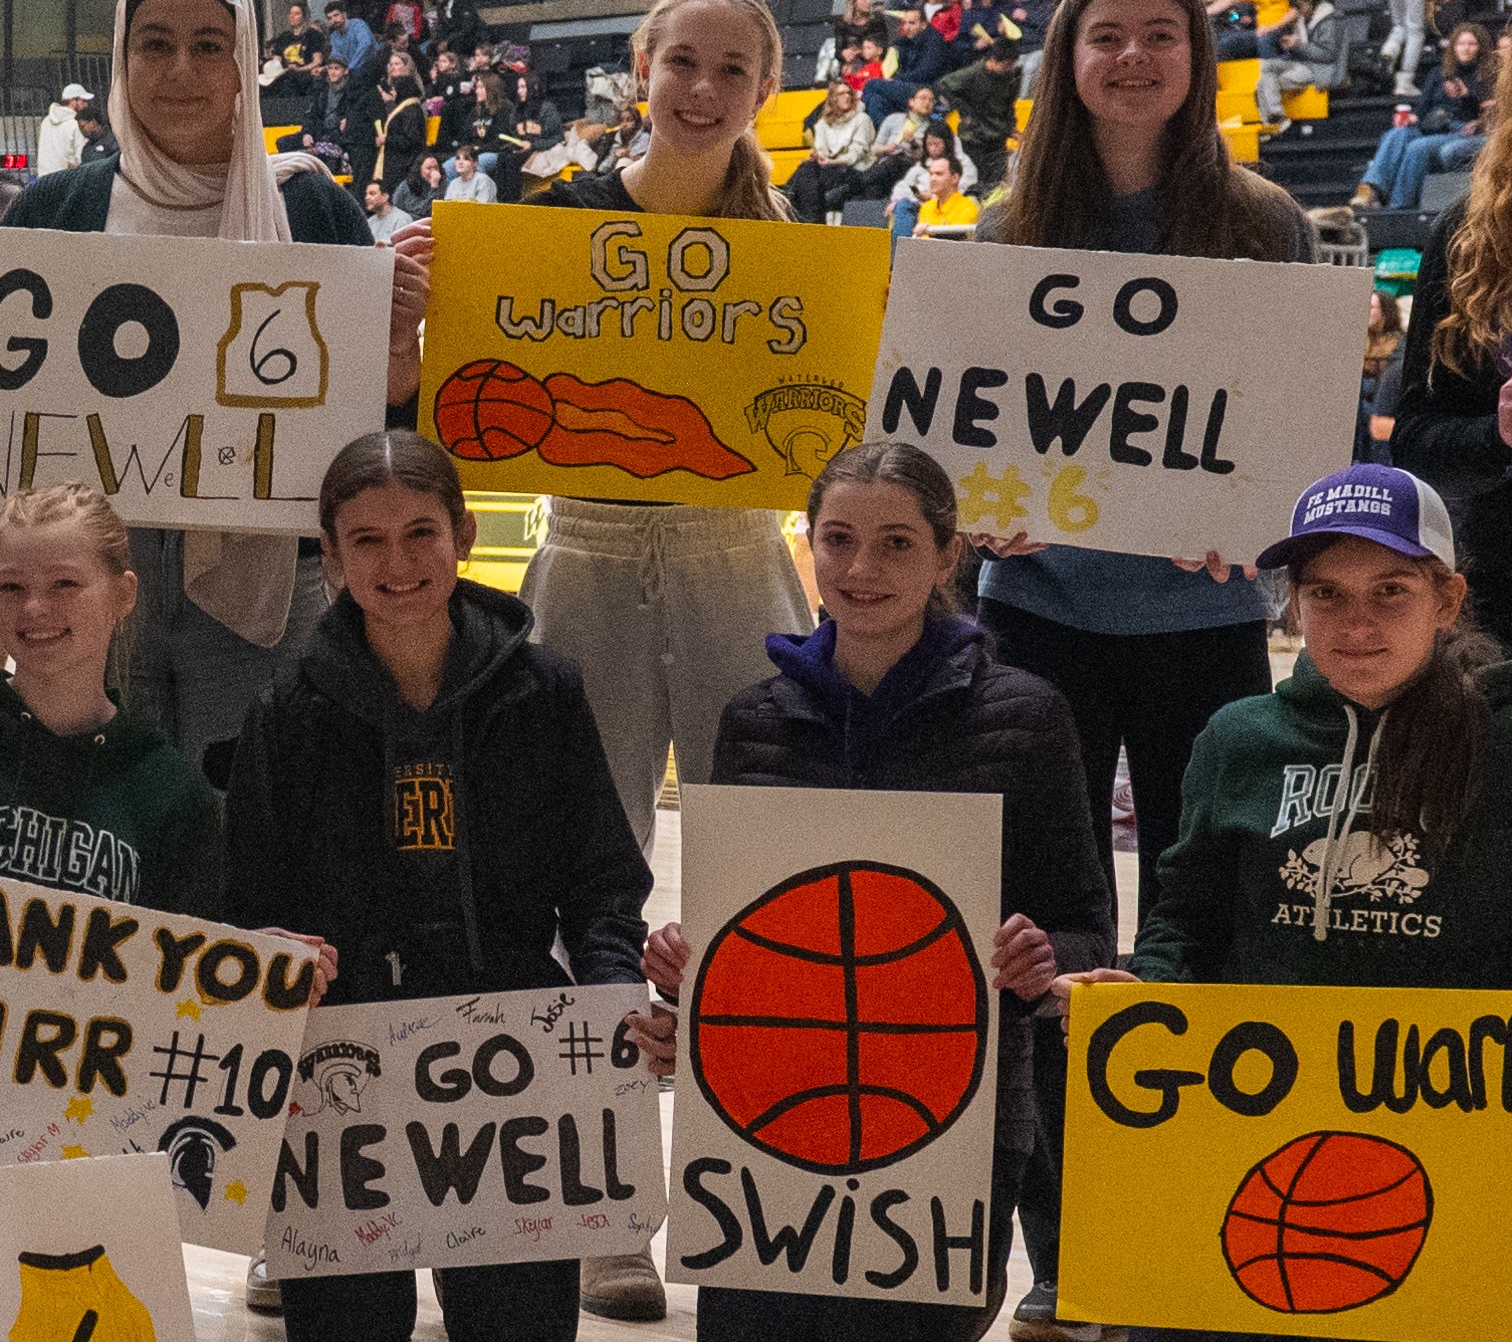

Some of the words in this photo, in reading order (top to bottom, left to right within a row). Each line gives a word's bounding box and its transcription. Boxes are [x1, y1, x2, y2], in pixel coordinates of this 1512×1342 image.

[590, 219, 731, 294] GO
[1027, 273, 1179, 337] GO
[249, 308, 298, 386] 6
[881, 365, 1236, 476] NEWELL
[957, 459, 1102, 535] #6
[1302, 499, 1392, 526] MUSTANGS
[1325, 483, 1394, 502] MADILL
[392, 762, 456, 779] ERSITY
[151, 925, 316, 1013] YOU
[149, 1030, 295, 1120] #10
[414, 1032, 535, 1104] GO
[270, 1107, 638, 1213] NEWELL
[280, 1225, 341, 1271] Alayna
[444, 1224, 489, 1251] Claire
